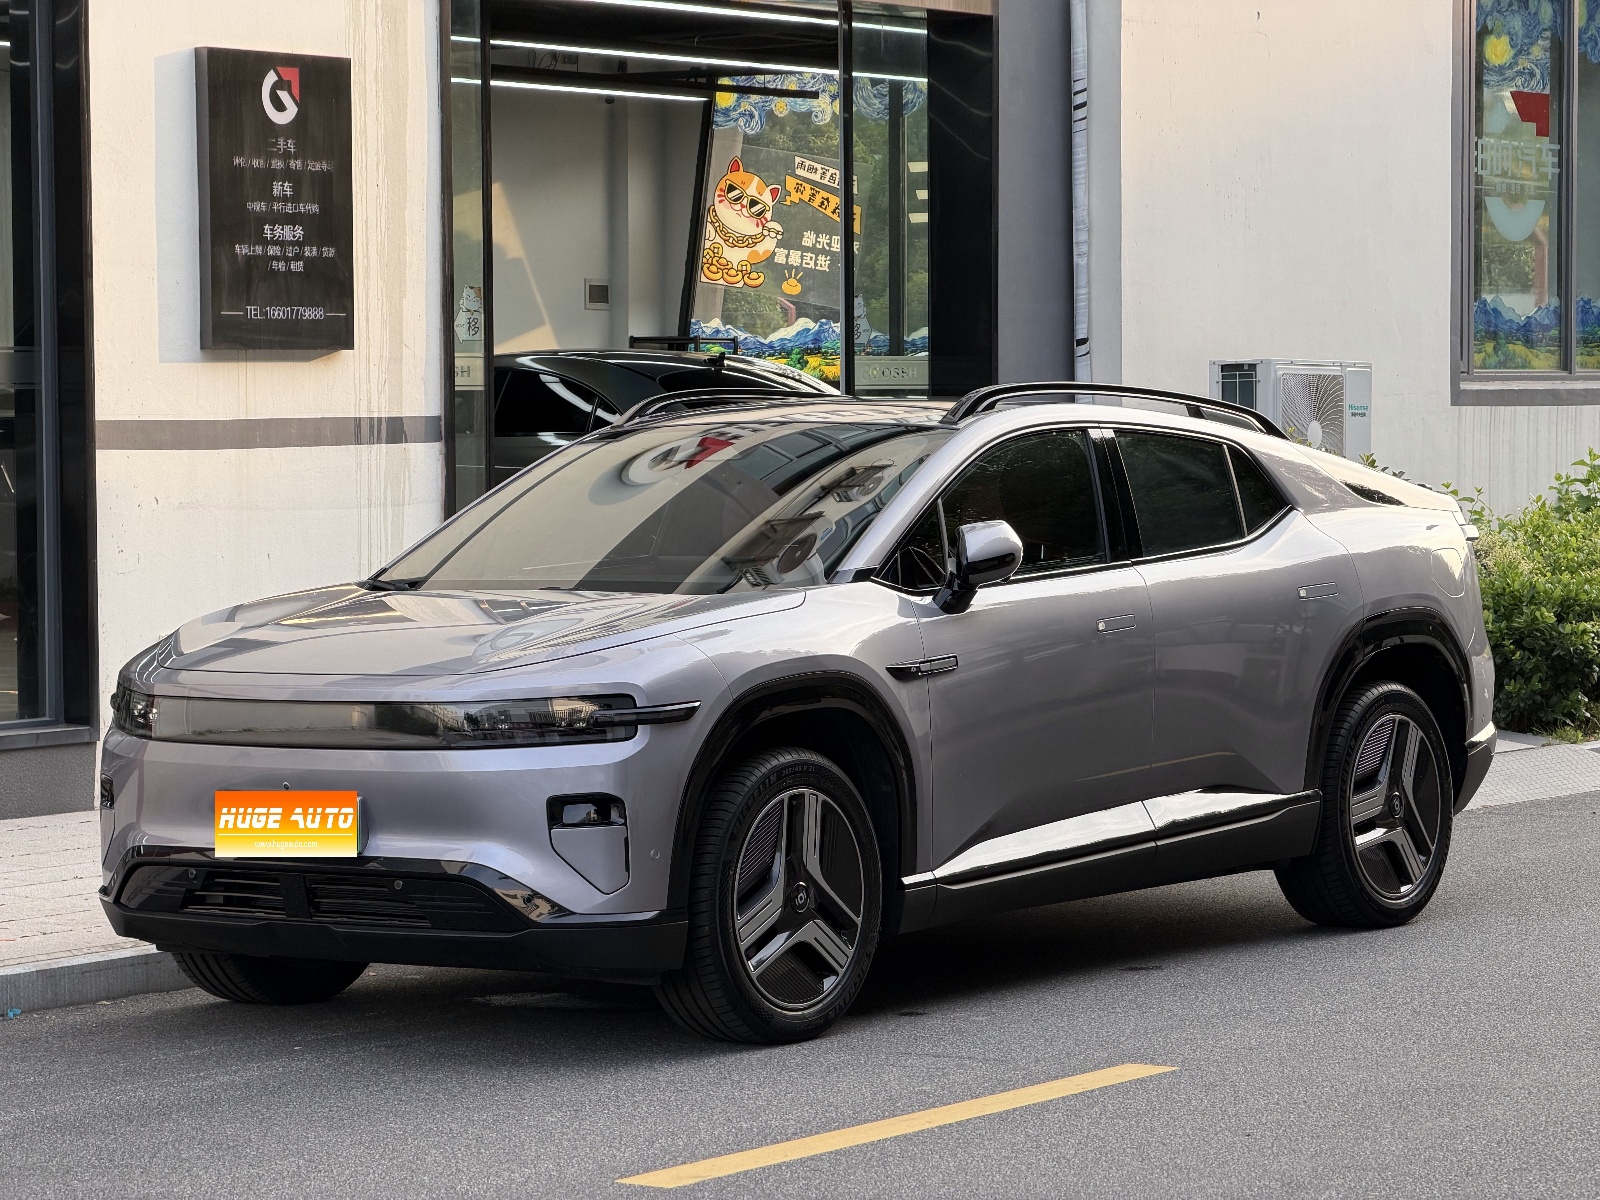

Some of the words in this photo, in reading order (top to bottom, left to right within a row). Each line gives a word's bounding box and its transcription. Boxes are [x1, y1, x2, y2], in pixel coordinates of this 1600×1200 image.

[268, 137, 297, 154] 二手车
[272, 181, 293, 198] 新车
[262, 224, 304, 241] 车务服务
[246, 306, 325, 320] TEL:16601779888
[467, 317, 479, 336] 移
